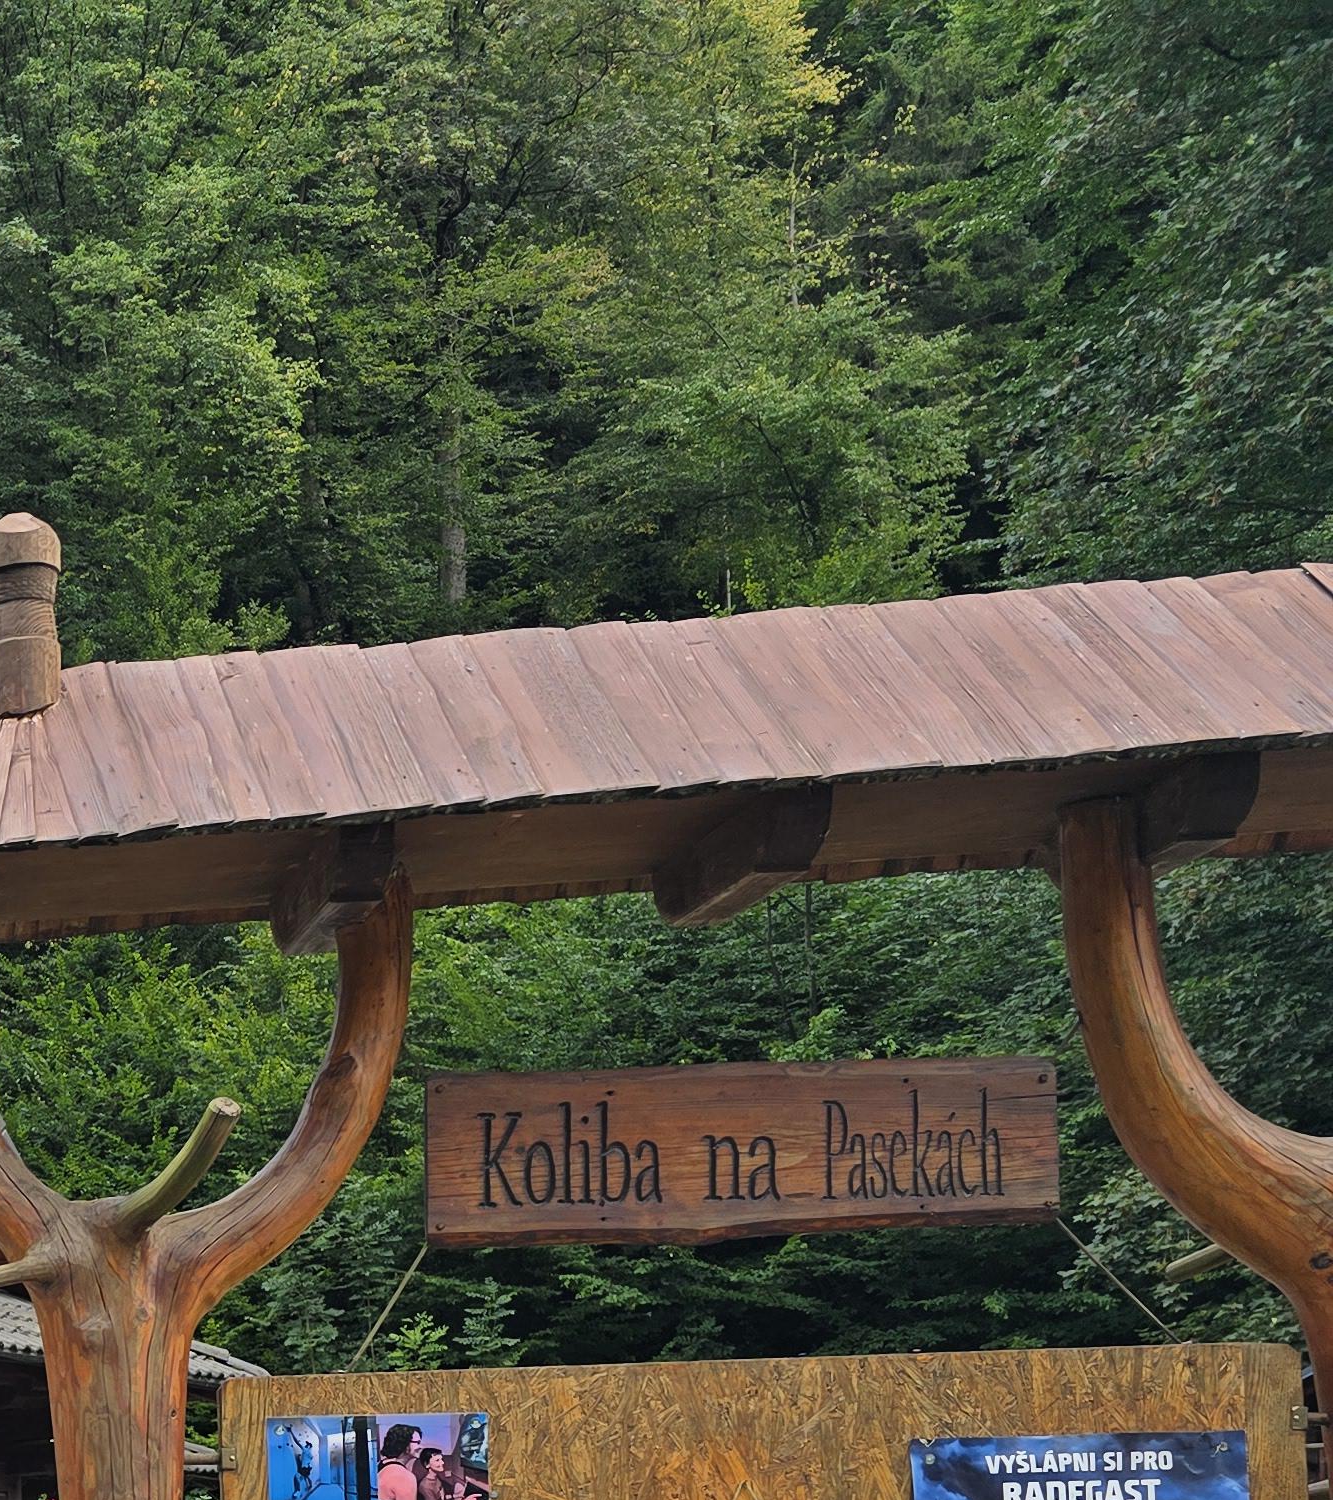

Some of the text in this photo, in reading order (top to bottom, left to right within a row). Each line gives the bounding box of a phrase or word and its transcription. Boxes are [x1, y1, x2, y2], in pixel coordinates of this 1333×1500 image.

[475, 1087, 1005, 1208] Koliba na Pasekách
[985, 1450, 1173, 1474] VYŠLÁPNI SI PRO
